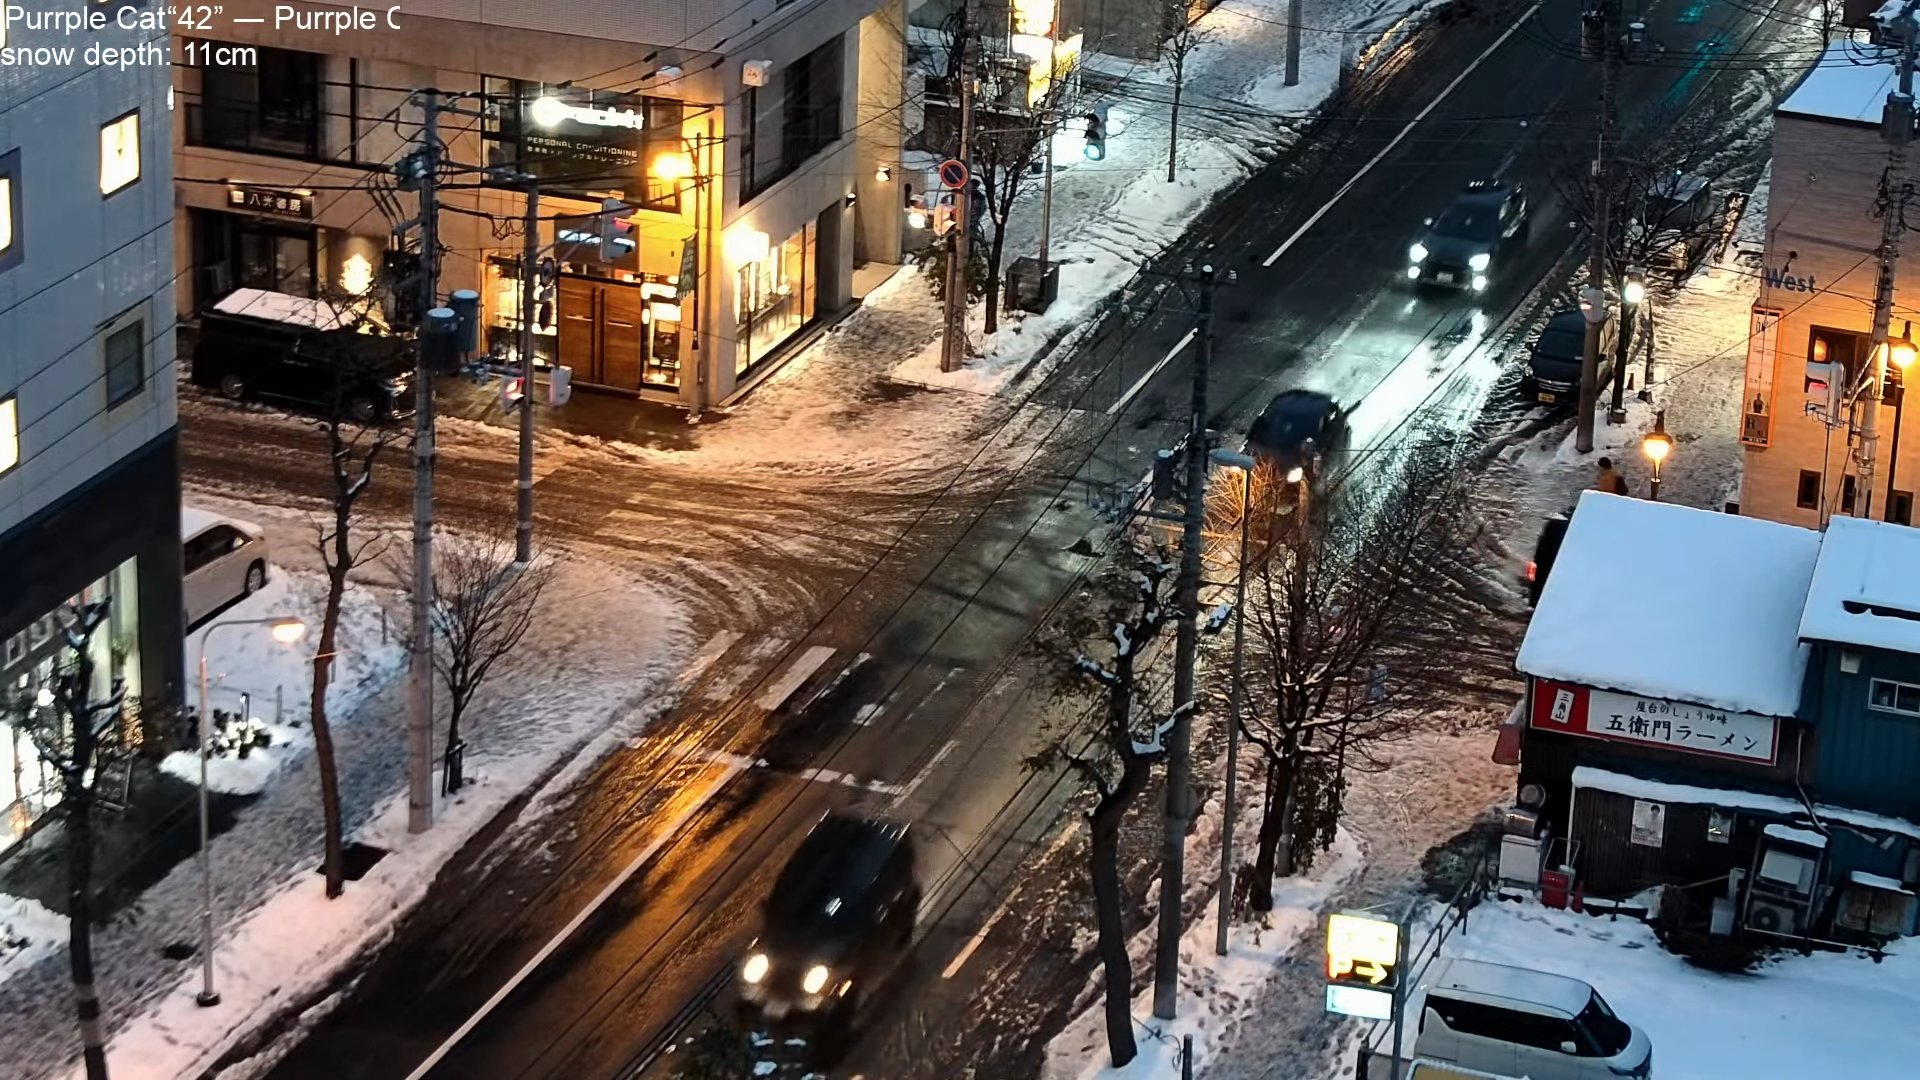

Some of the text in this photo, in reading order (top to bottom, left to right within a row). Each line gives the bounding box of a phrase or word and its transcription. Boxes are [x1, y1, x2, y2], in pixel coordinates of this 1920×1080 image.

[527, 136, 573, 148] PERSONAL
[1766, 267, 1816, 293] West
[1636, 701, 1728, 725] 屋台のしょうゆ味
[1605, 714, 1758, 751] 五衛門ラーメン
